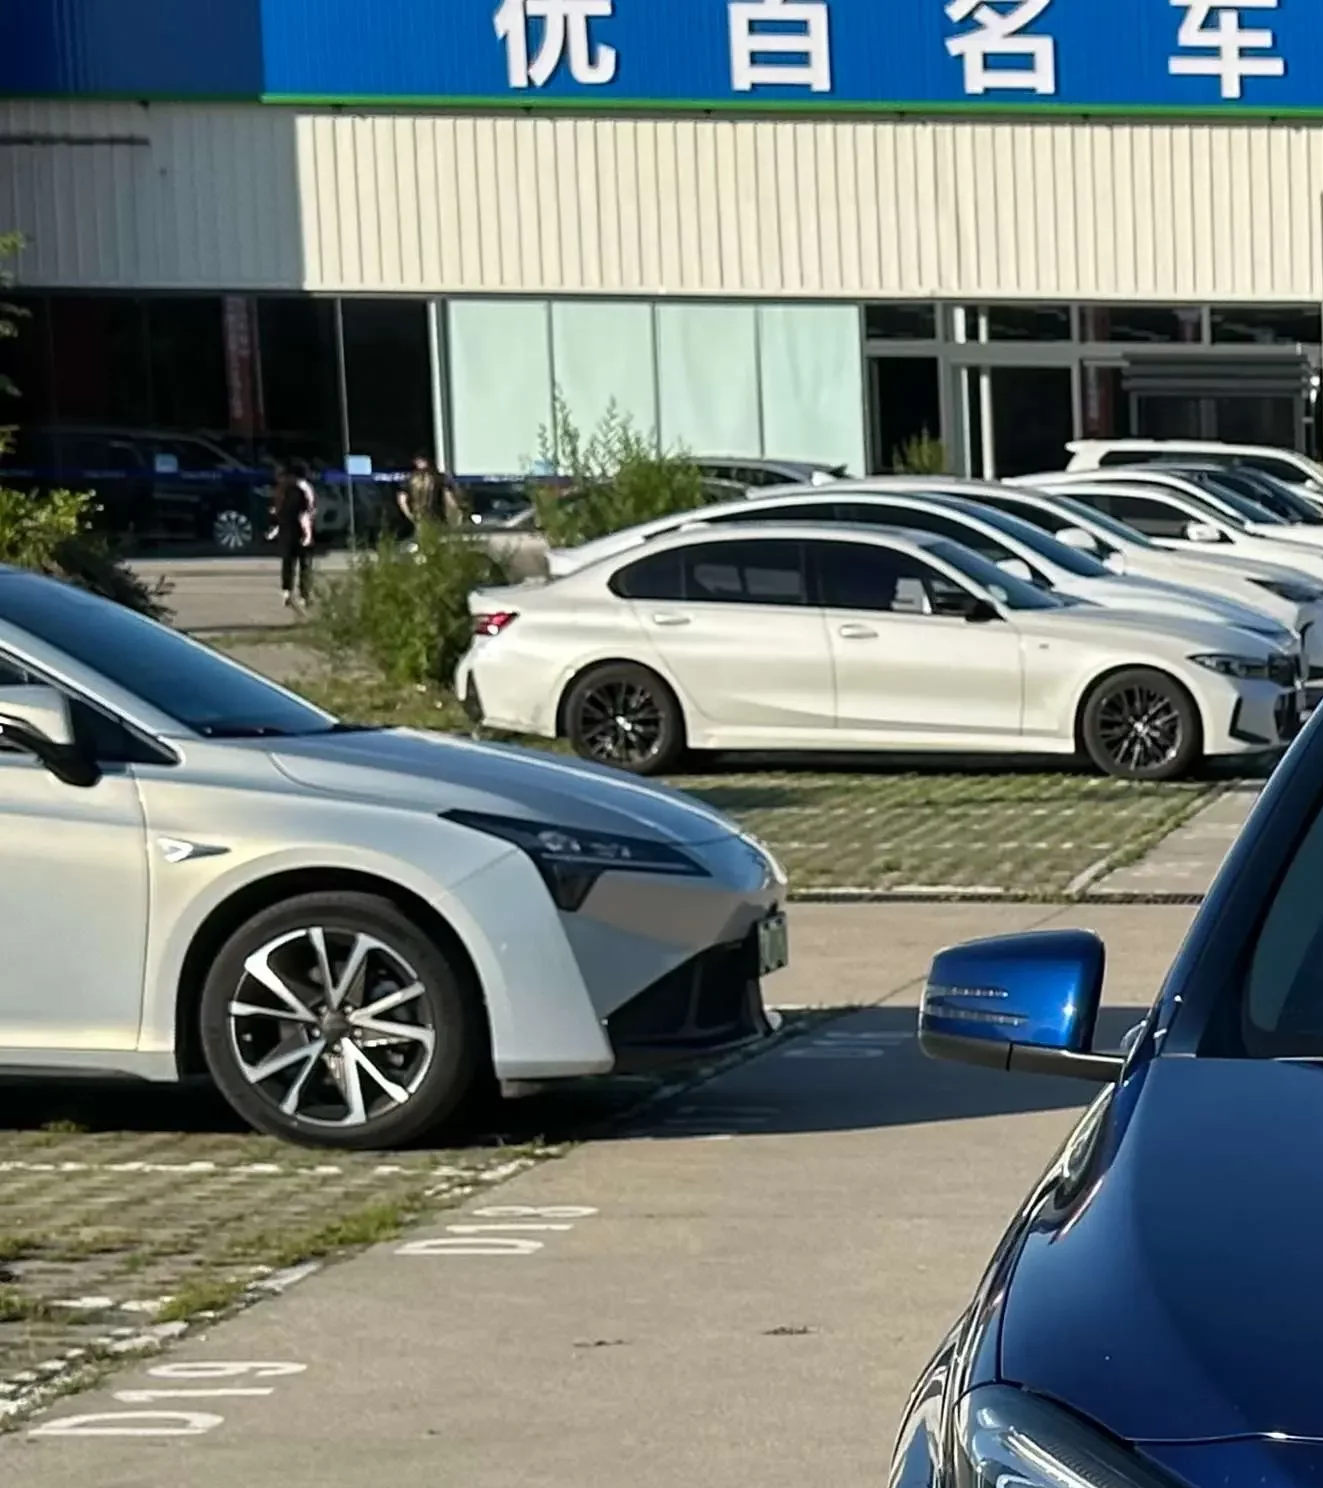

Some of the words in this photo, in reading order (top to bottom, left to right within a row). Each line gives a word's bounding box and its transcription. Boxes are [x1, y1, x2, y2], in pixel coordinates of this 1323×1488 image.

[493, 0, 1285, 98] 优百名车
[28, 1361, 307, 1437] D19
